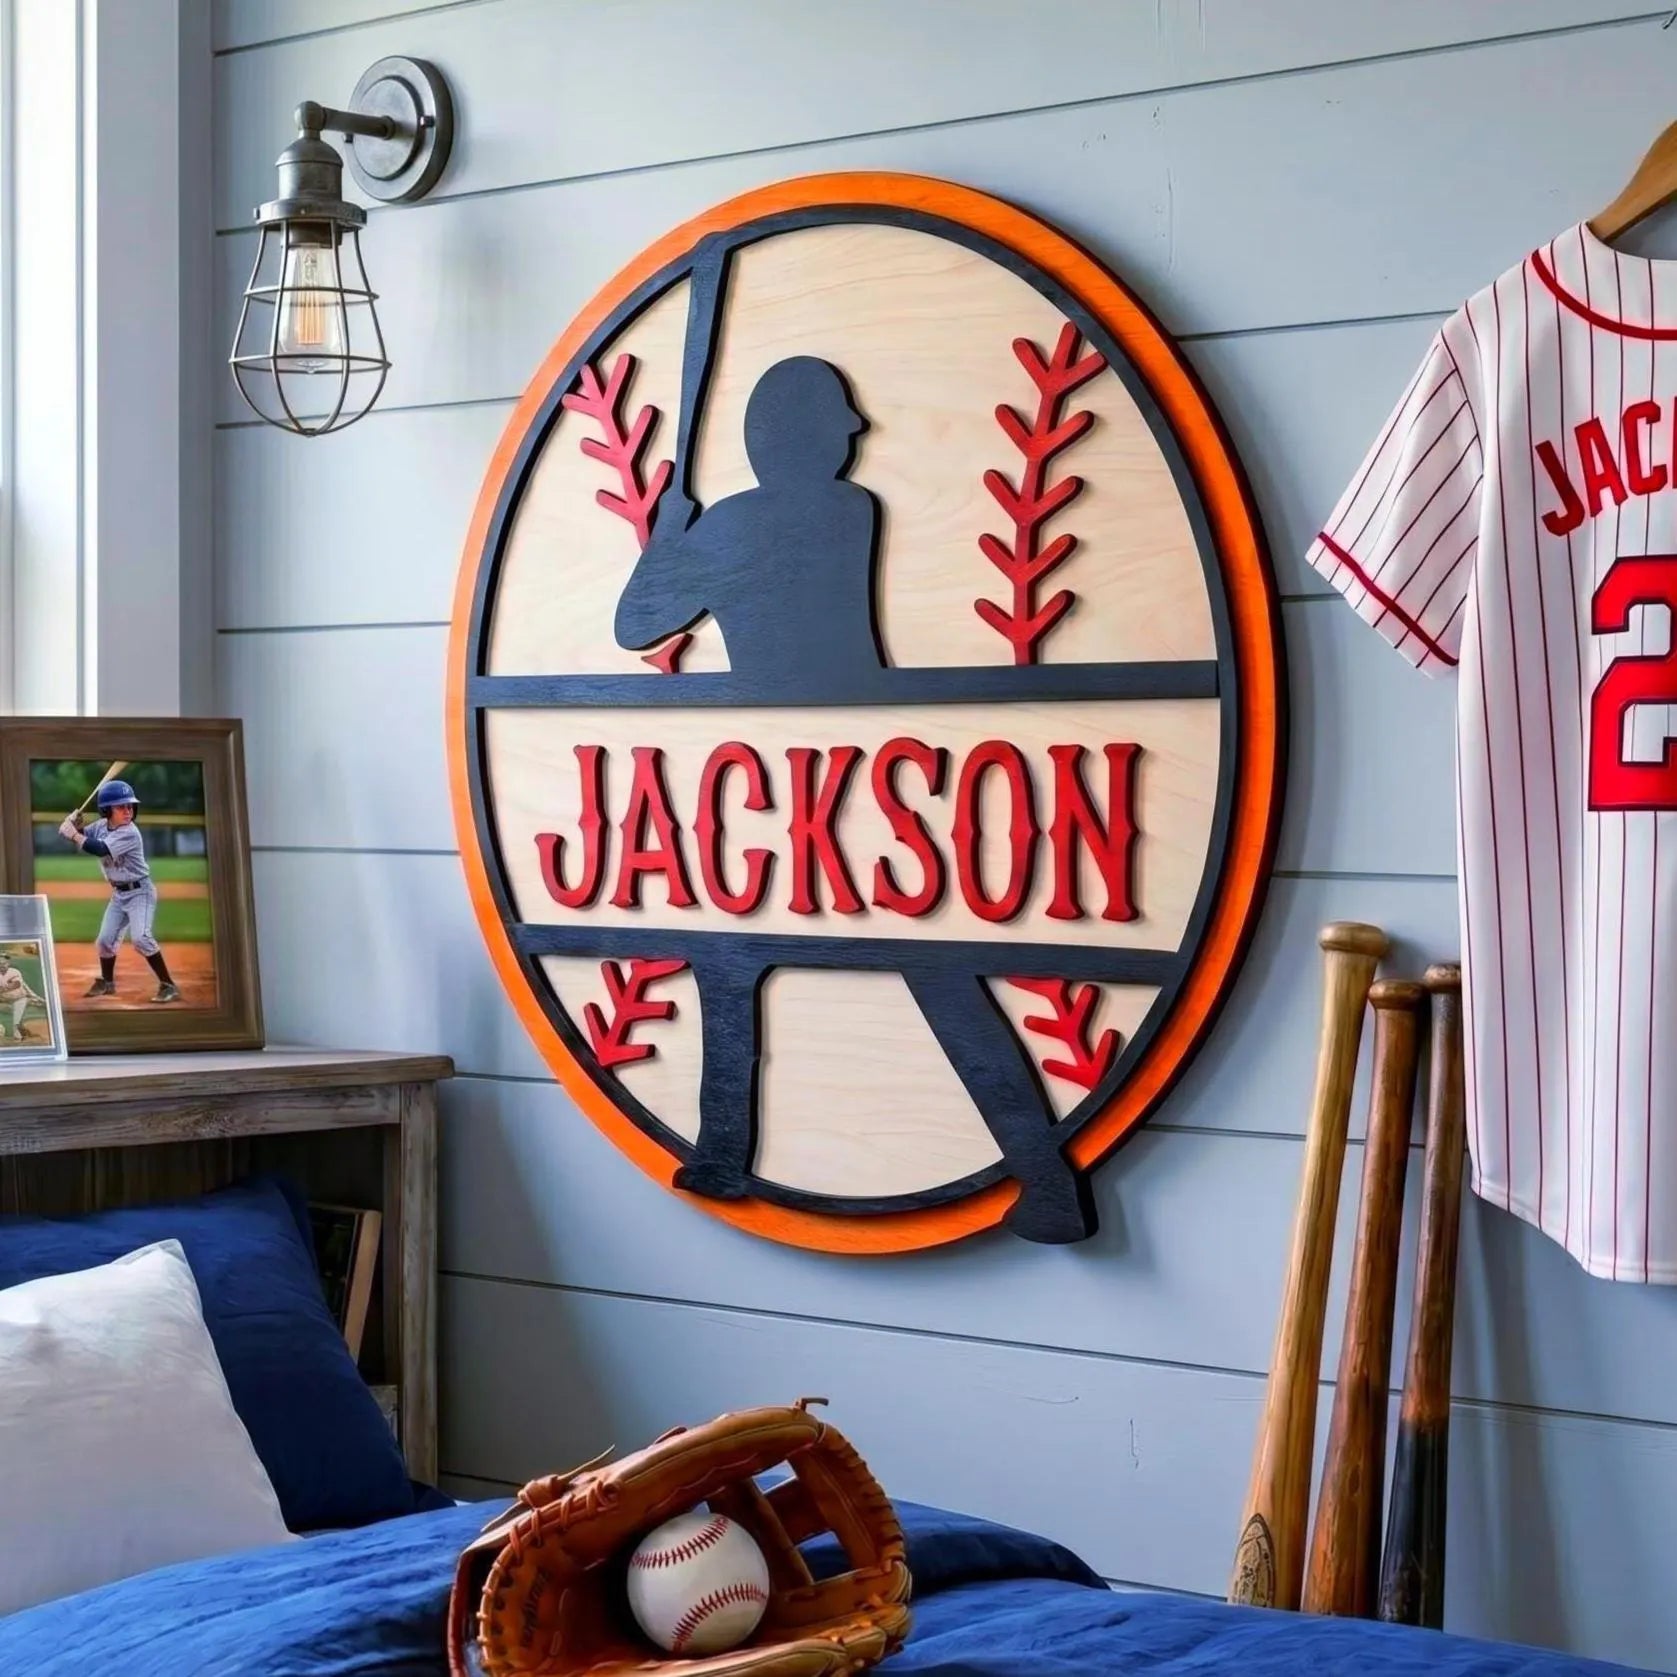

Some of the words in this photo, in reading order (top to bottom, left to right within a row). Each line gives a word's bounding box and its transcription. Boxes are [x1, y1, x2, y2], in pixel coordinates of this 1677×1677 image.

[1535, 396, 1677, 536] JAC
[1588, 554, 1677, 811] 2
[534, 737, 1142, 923] JACKSON
